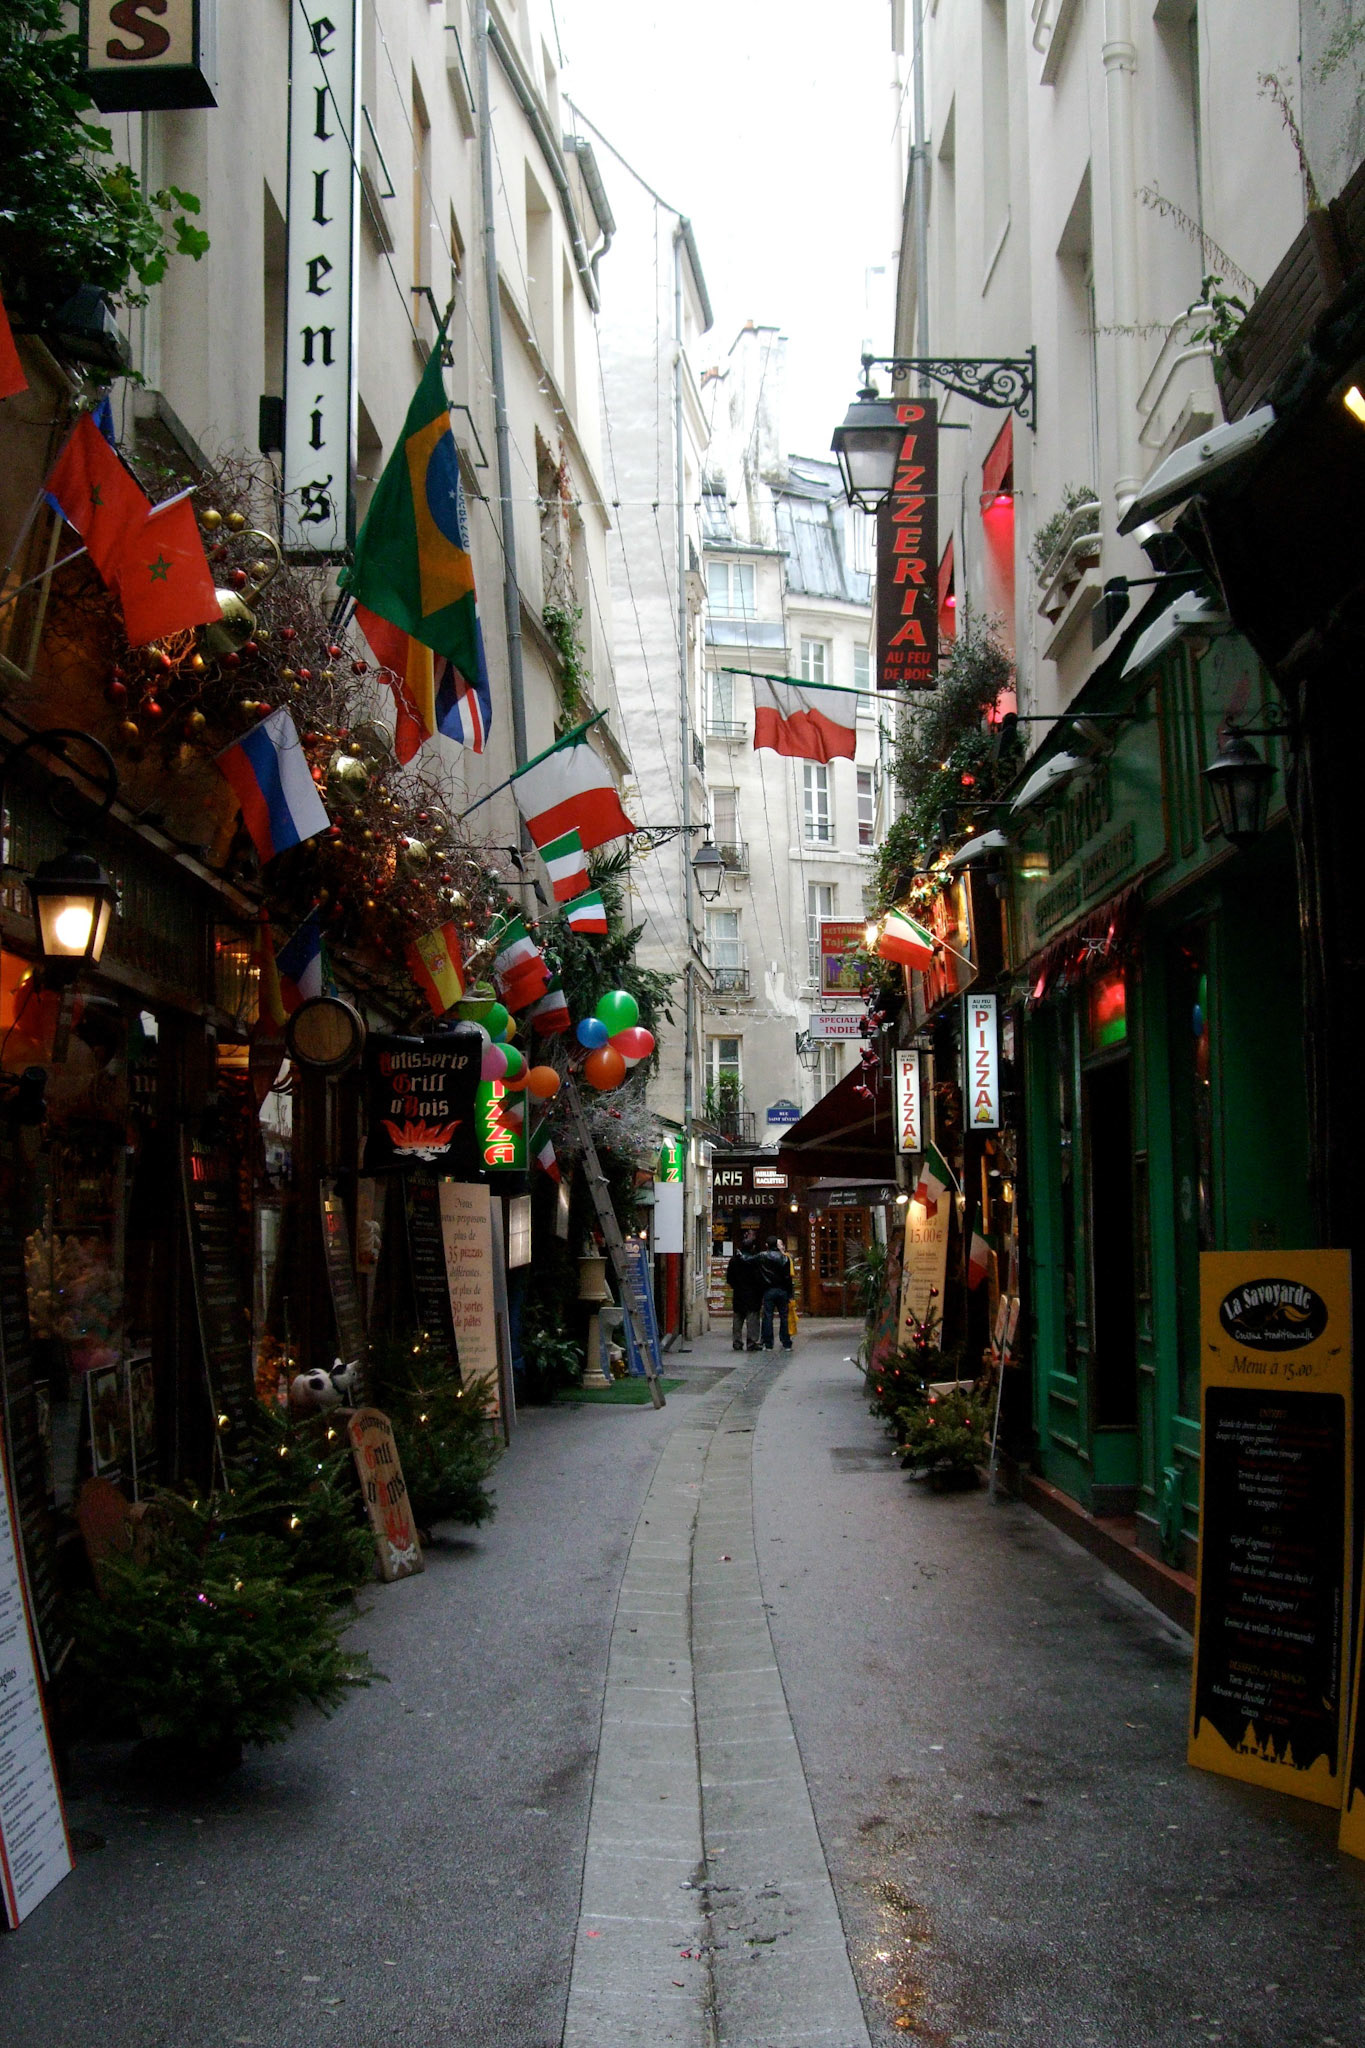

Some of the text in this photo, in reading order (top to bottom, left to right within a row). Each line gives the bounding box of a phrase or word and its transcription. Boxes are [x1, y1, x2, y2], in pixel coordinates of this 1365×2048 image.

[106, 0, 170, 60] S
[299, 16, 337, 524] ellenis
[889, 404, 927, 646] PIZZERIA
[883, 667, 900, 680] DE
[885, 651, 932, 664] AU FEU
[974, 1010, 992, 1108] PIZZA
[392, 1073, 448, 1094] Grill
[903, 1063, 916, 1136] PIZZA
[484, 1080, 516, 1166] IZZA
[717, 1194, 775, 1206] PIERRADES
[460, 1246, 484, 1262] pizzas
[1223, 1283, 1312, 1321] La Savoyarde
[1231, 1355, 1268, 1375] Menu
